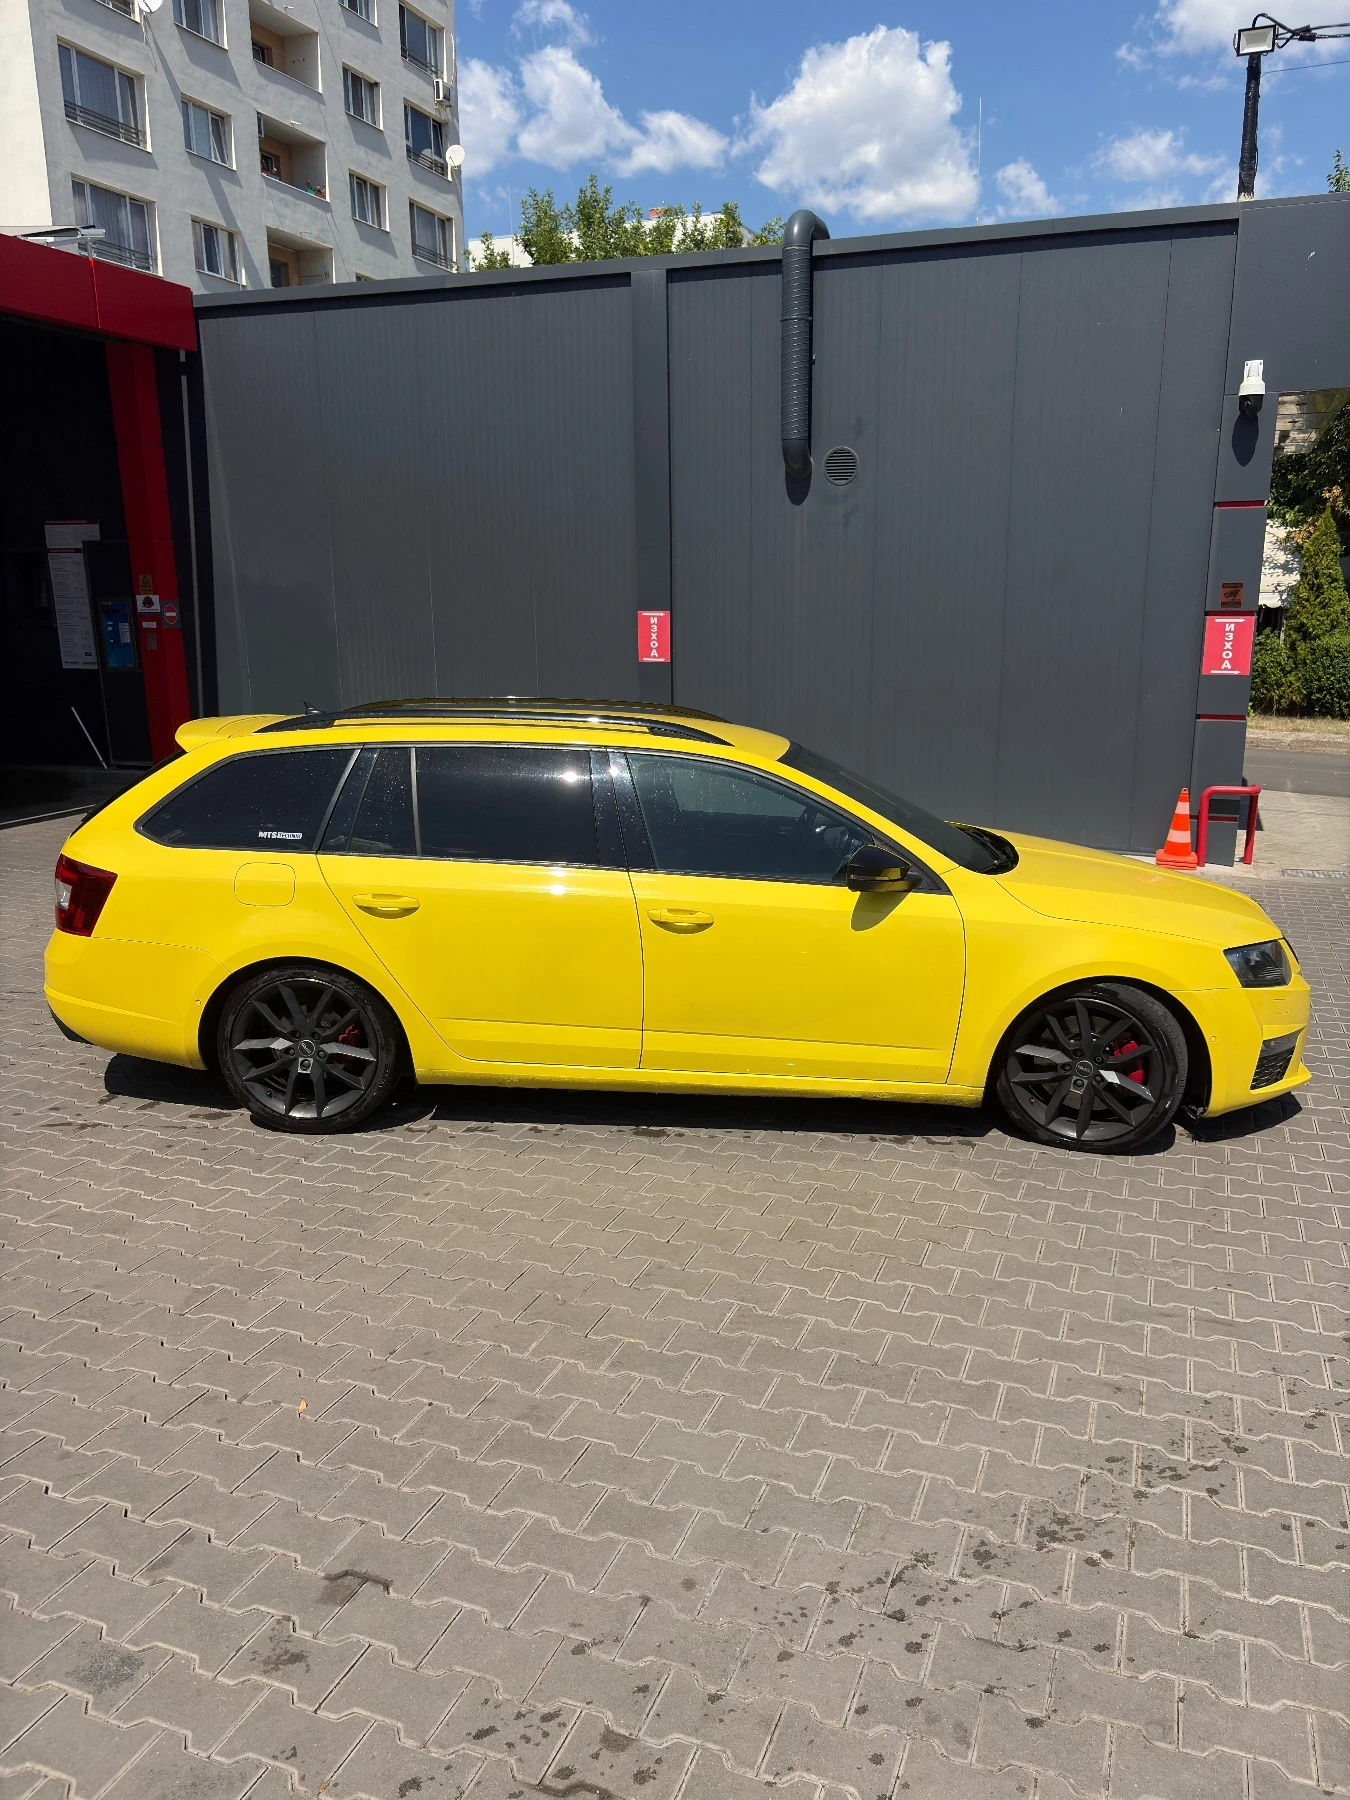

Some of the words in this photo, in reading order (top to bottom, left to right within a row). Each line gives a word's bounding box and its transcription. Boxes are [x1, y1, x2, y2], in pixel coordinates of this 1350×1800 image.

[650, 616, 659, 658] ИЗХОД
[1221, 623, 1235, 670] ИЗХОД
[258, 831, 277, 839] MTS
